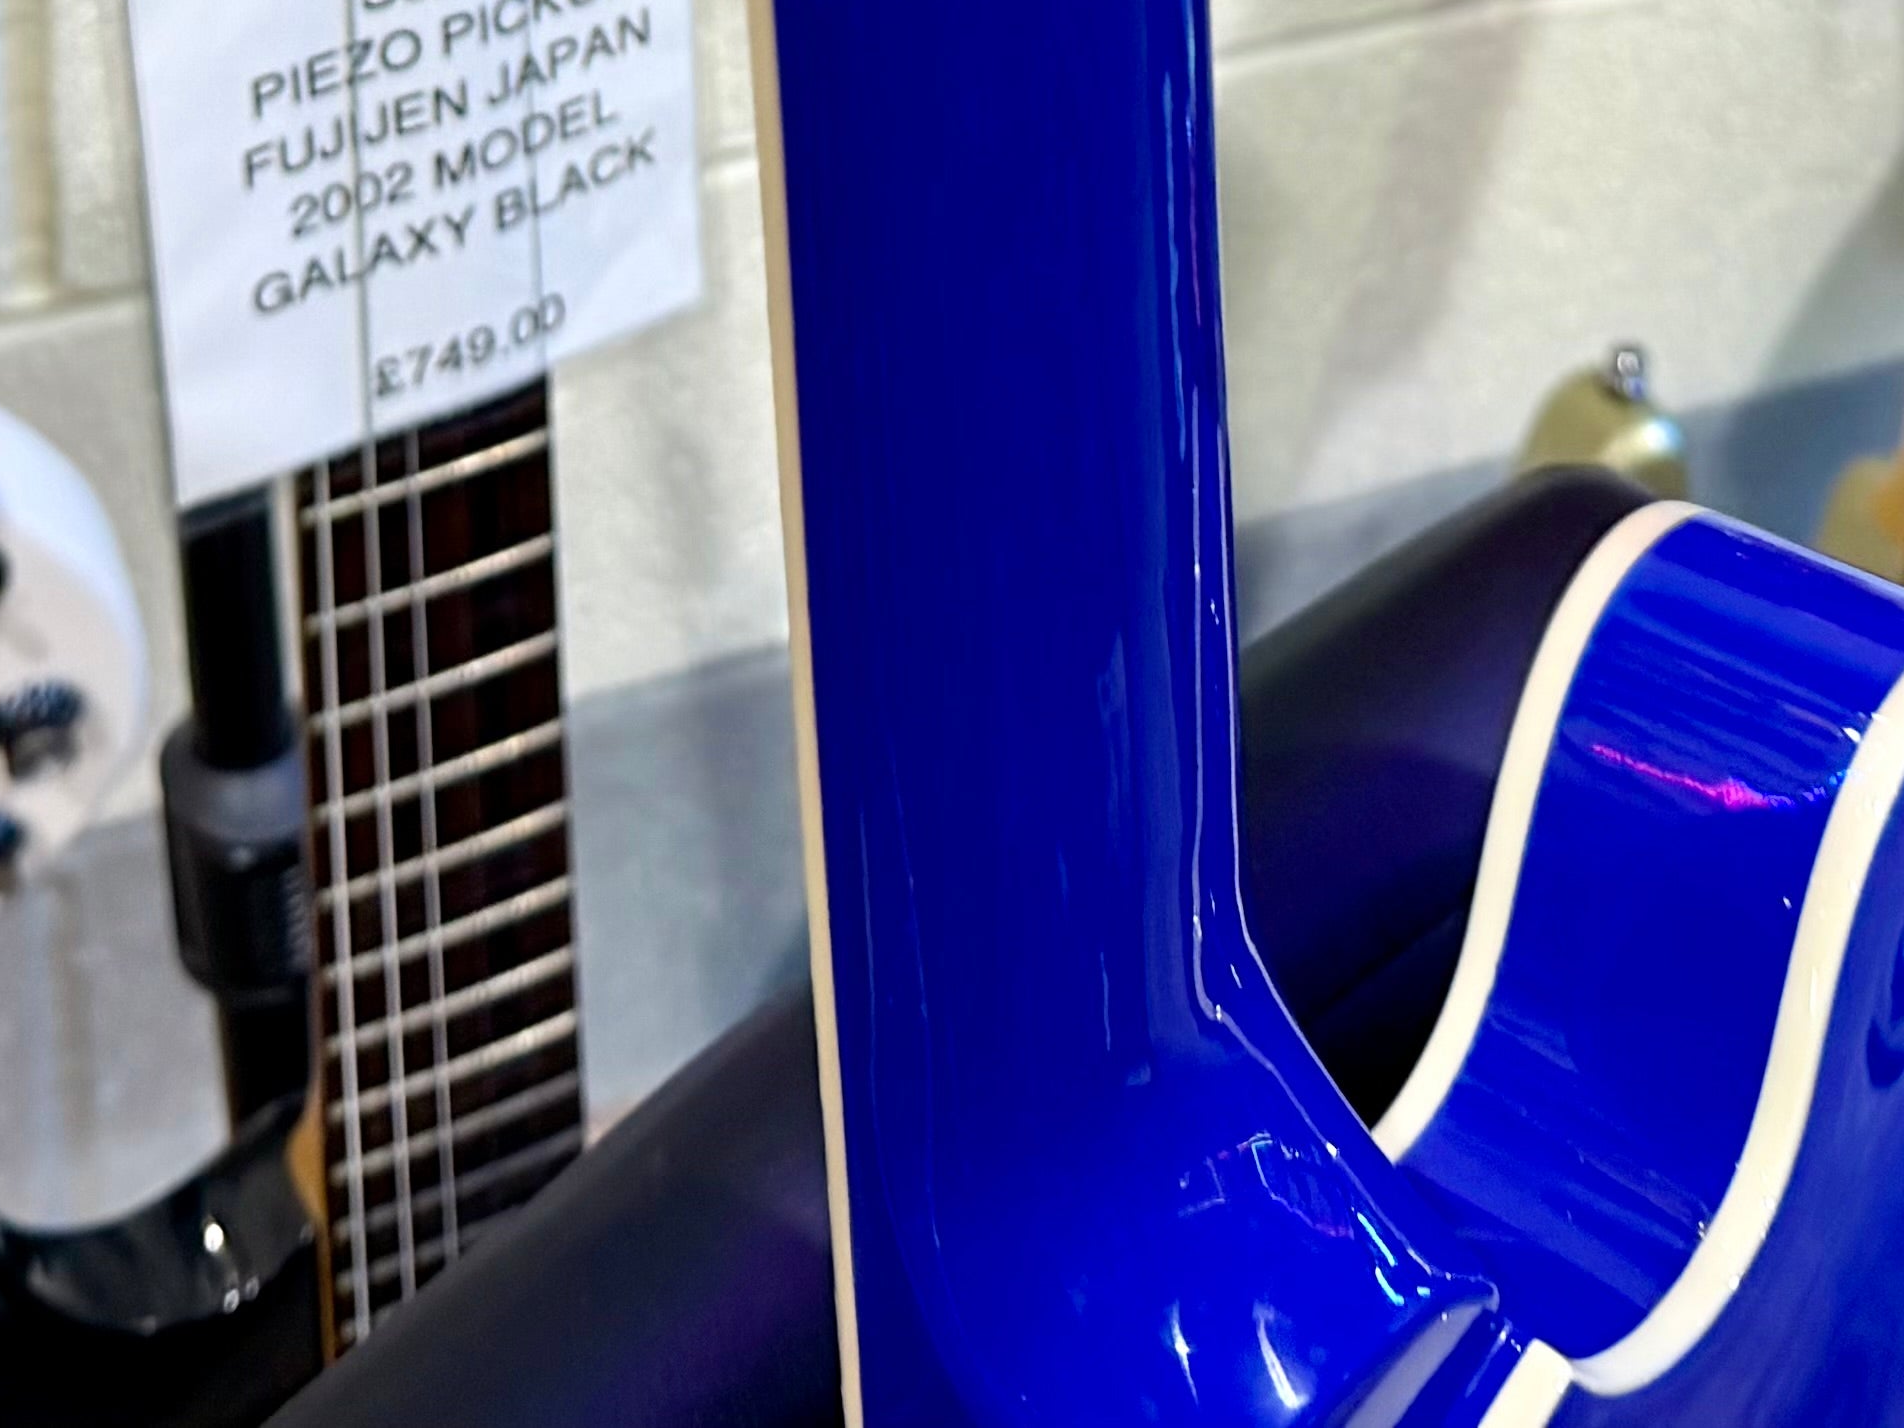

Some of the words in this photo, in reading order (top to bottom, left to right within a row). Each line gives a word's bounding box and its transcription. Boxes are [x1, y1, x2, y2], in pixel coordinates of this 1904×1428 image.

[251, 27, 423, 120] PIEZO
[487, 7, 654, 108] JAPAN
[288, 160, 417, 241] 2002
[432, 87, 620, 192] MODEL
[252, 204, 476, 319] GALAXY
[494, 125, 658, 232] BLACK
[372, 290, 568, 402] £749.00
